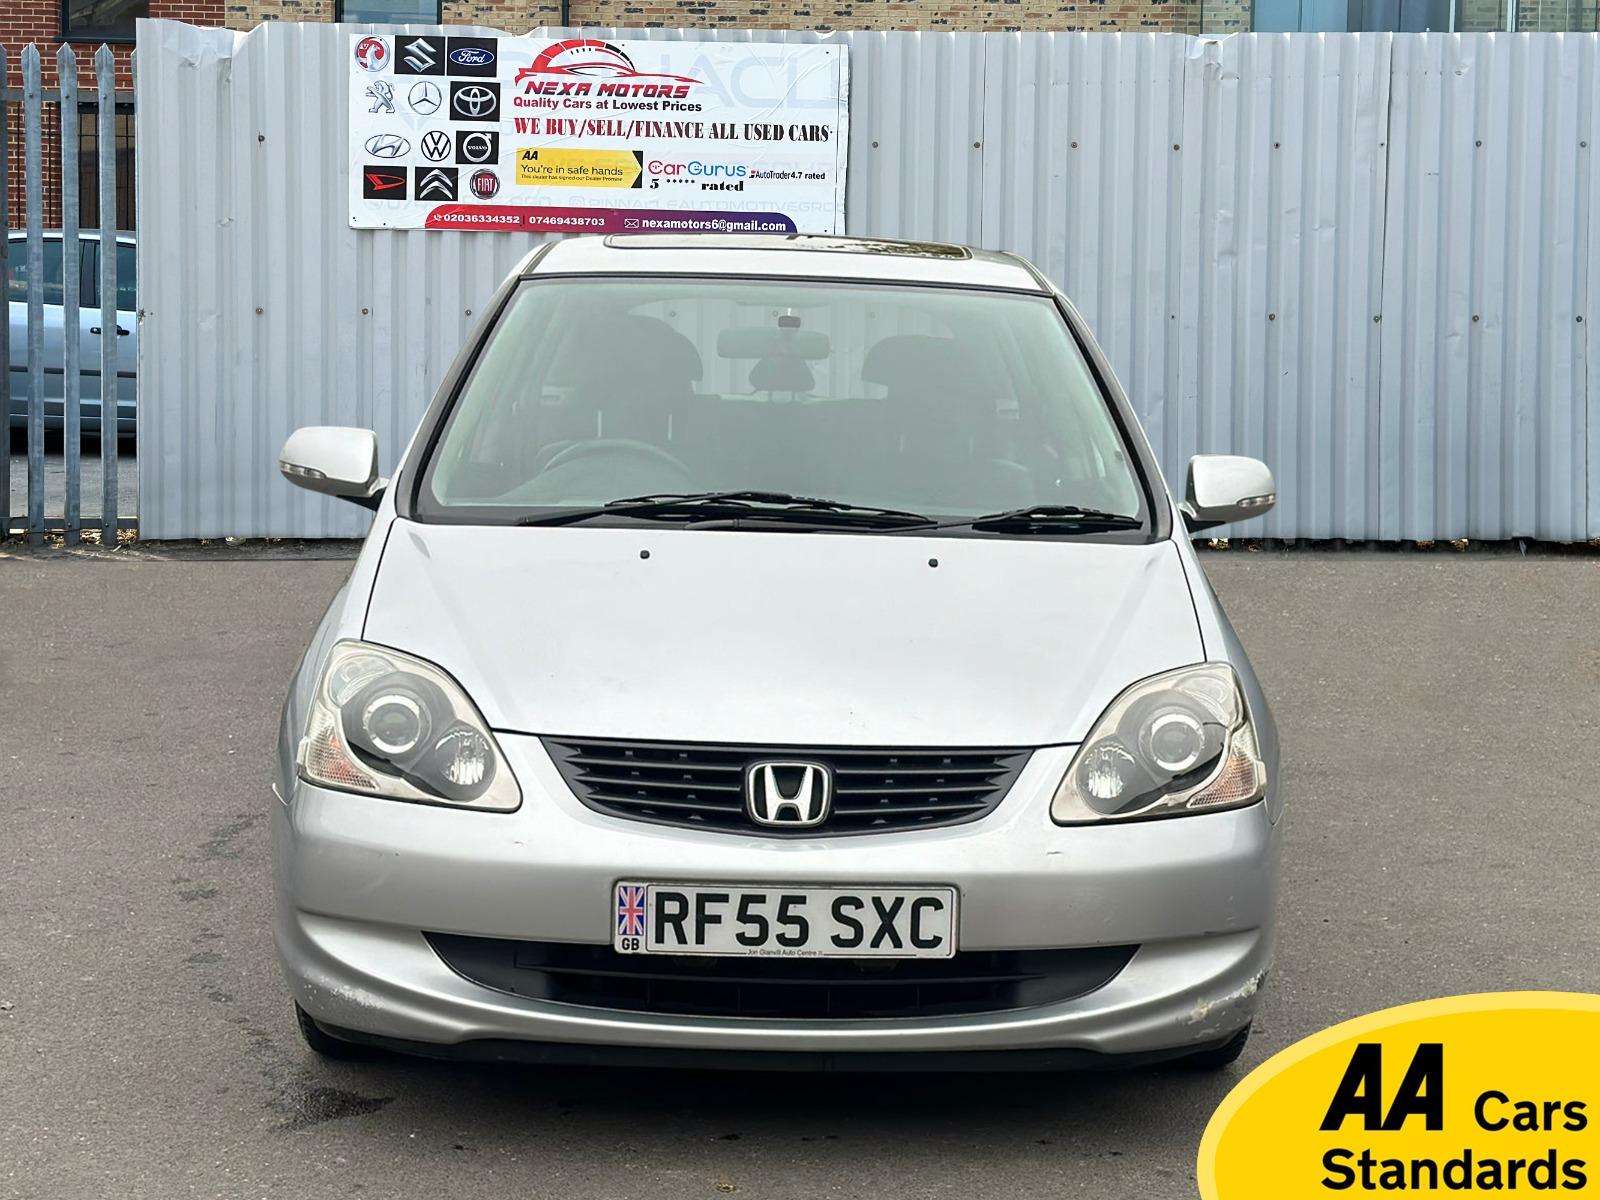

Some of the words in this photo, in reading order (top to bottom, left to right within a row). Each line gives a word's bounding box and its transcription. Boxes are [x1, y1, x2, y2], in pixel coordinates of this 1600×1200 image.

[458, 49, 485, 63] Ford
[524, 81, 592, 95] NEXA
[596, 83, 690, 99] MOTORS
[513, 96, 559, 110] Quality
[563, 98, 592, 109] Cars
[596, 99, 609, 109] at
[612, 99, 659, 111] Lowest
[662, 100, 702, 111] Prices
[514, 117, 541, 135] WE
[546, 118, 704, 139] BUY/SELL/FINANCE
[709, 122, 739, 140] ALL
[744, 123, 784, 141] USED
[521, 150, 539, 161] AA
[521, 164, 554, 174] You're
[555, 165, 565, 174] in
[567, 165, 589, 175] safe
[591, 166, 623, 176] hands
[648, 160, 747, 177] CarGurus
[755, 170, 791, 180] AutoTrader
[791, 171, 803, 179] 4.7
[804, 172, 826, 180] rated
[477, 178, 493, 192] FIAT
[650, 178, 659, 189] 5
[701, 180, 744, 191] rated
[443, 213, 520, 224] 02036334352
[529, 216, 605, 226] 07469438703
[642, 218, 786, 231] nexamotors6@gmail.com
[654, 891, 810, 949] RF55
[829, 895, 945, 950] SXC
[621, 937, 640, 951] GB
[796, 949, 817, 957] Centre
